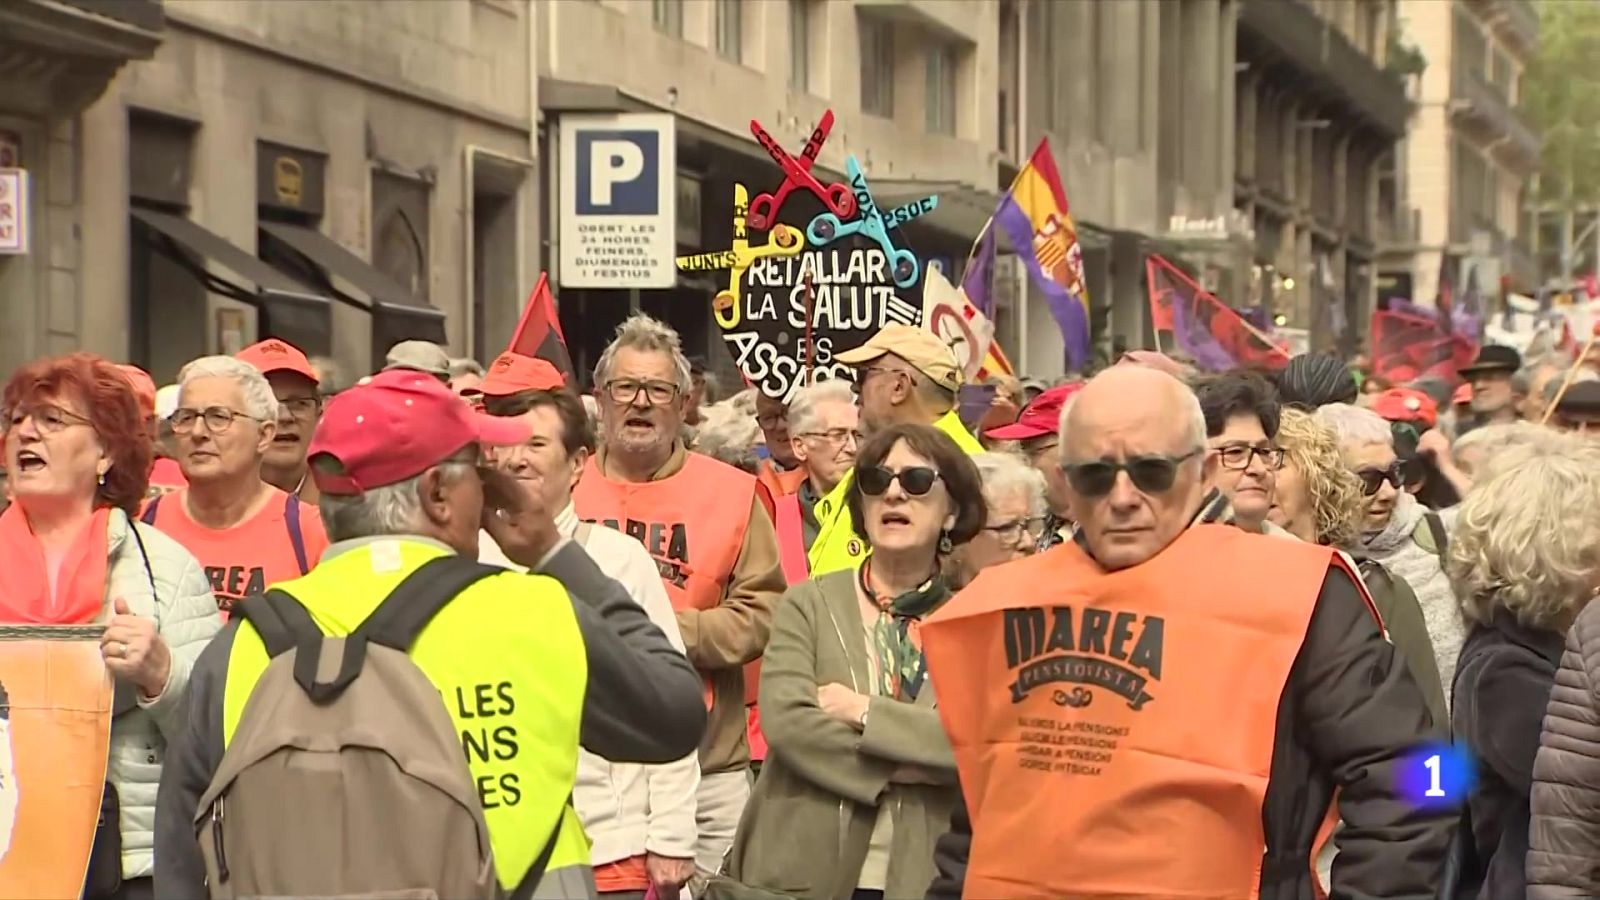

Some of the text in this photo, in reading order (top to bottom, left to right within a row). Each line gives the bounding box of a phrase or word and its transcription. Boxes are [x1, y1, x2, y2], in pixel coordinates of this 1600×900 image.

[590, 141, 644, 205] P
[852, 173, 877, 222] VOX
[882, 196, 932, 229] PSOE
[578, 224, 656, 233] OBERT LES
[575, 258, 658, 267] DIUMENGES
[582, 270, 651, 278] I FESTIUS
[748, 249, 886, 286] RETALLAR
[746, 293, 778, 320] LA
[204, 566, 265, 597] REA
[1003, 606, 1165, 682] MAREA
[456, 681, 515, 719] LES
